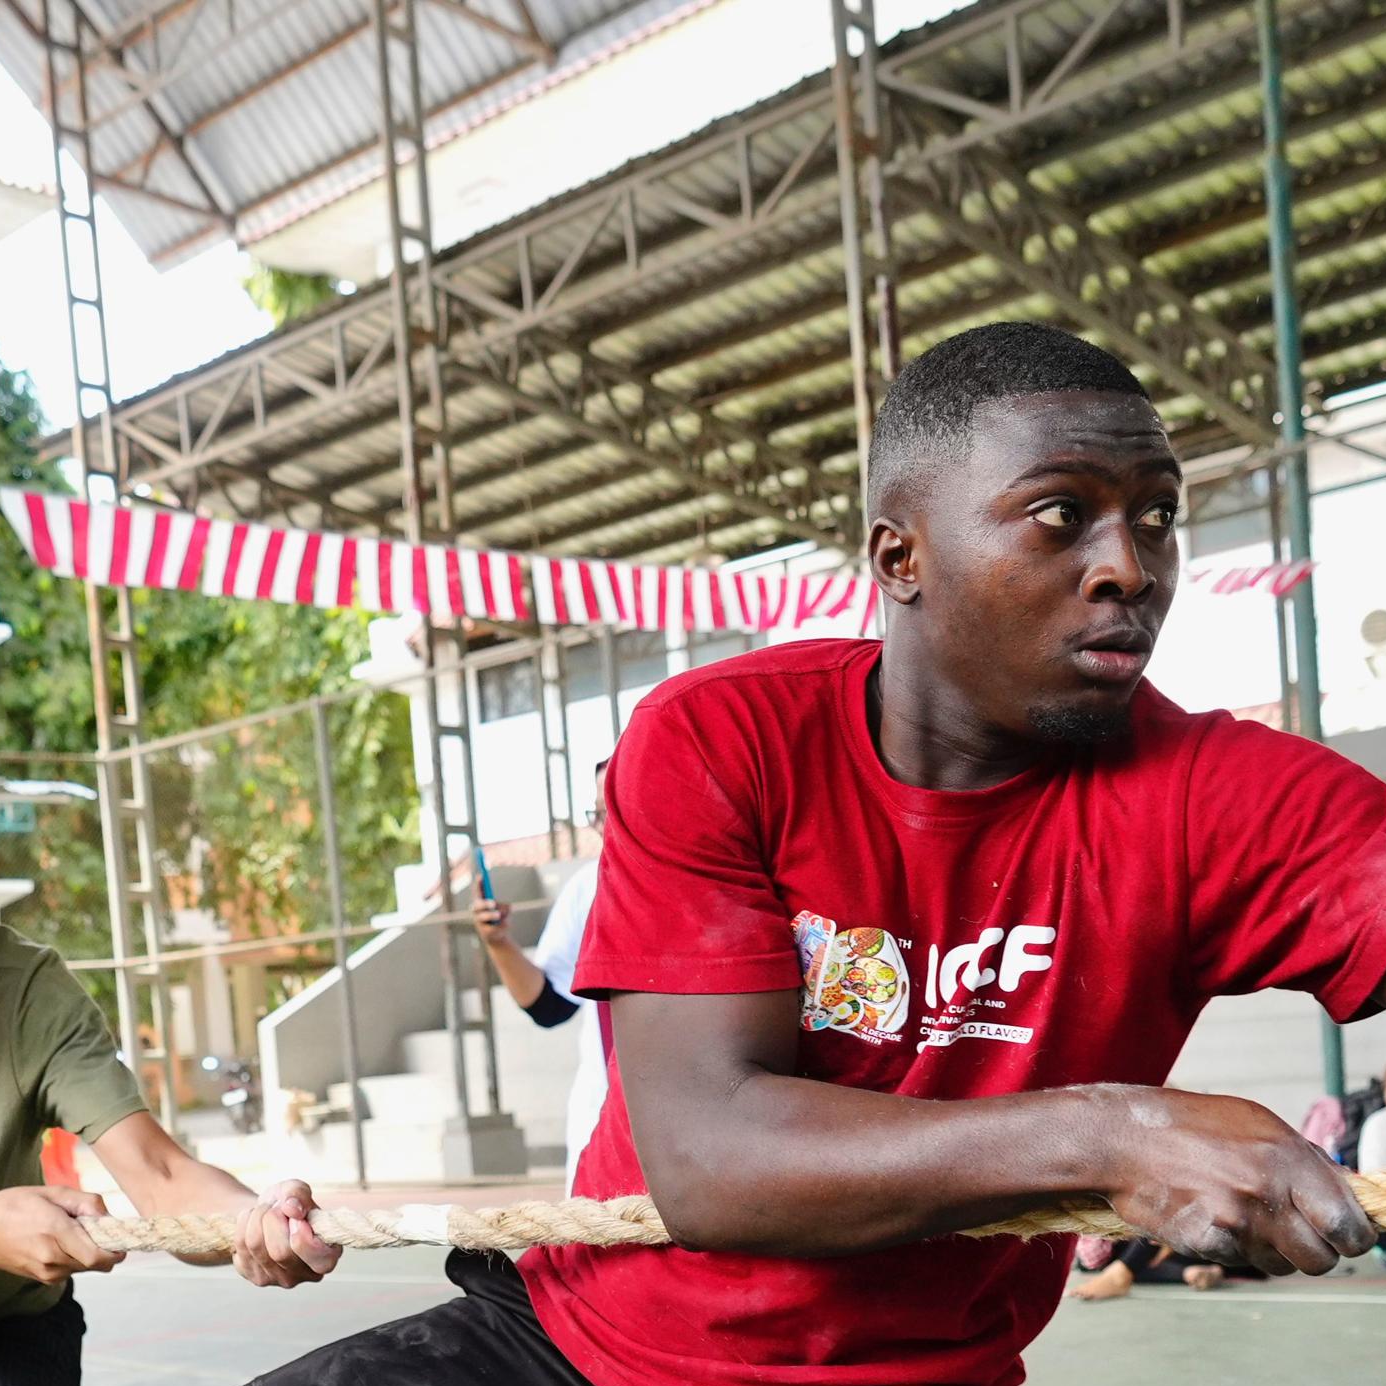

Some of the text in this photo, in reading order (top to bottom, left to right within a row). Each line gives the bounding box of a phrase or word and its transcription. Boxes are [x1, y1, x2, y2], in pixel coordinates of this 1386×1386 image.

[897, 937, 912, 950] TH
[984, 999, 1007, 1009] AND
[859, 1032, 883, 1046] WITH
[868, 1028, 903, 1042] DECADE
[948, 1025, 977, 1043] WLD
